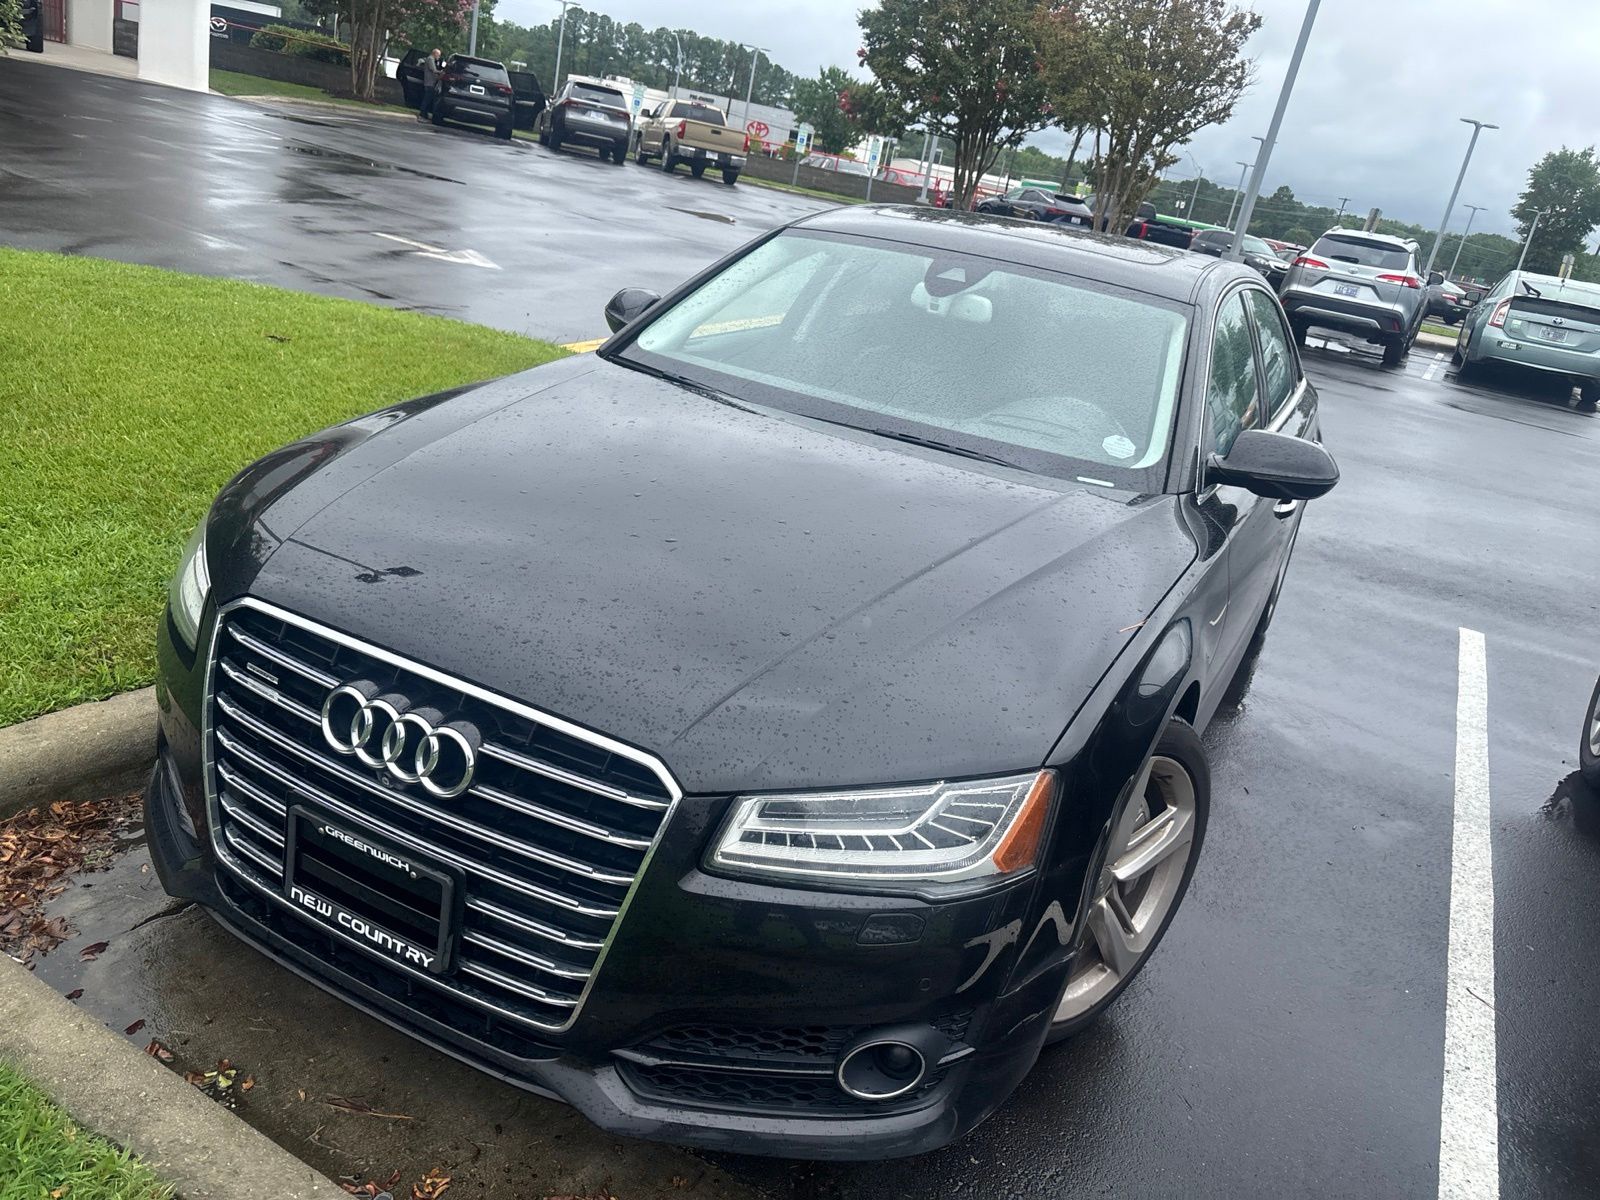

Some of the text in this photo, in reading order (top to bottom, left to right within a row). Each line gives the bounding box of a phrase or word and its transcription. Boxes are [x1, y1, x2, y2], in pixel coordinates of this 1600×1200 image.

[325, 825, 409, 872] GREENWICH
[290, 886, 434, 967] NEW COUNTRY
